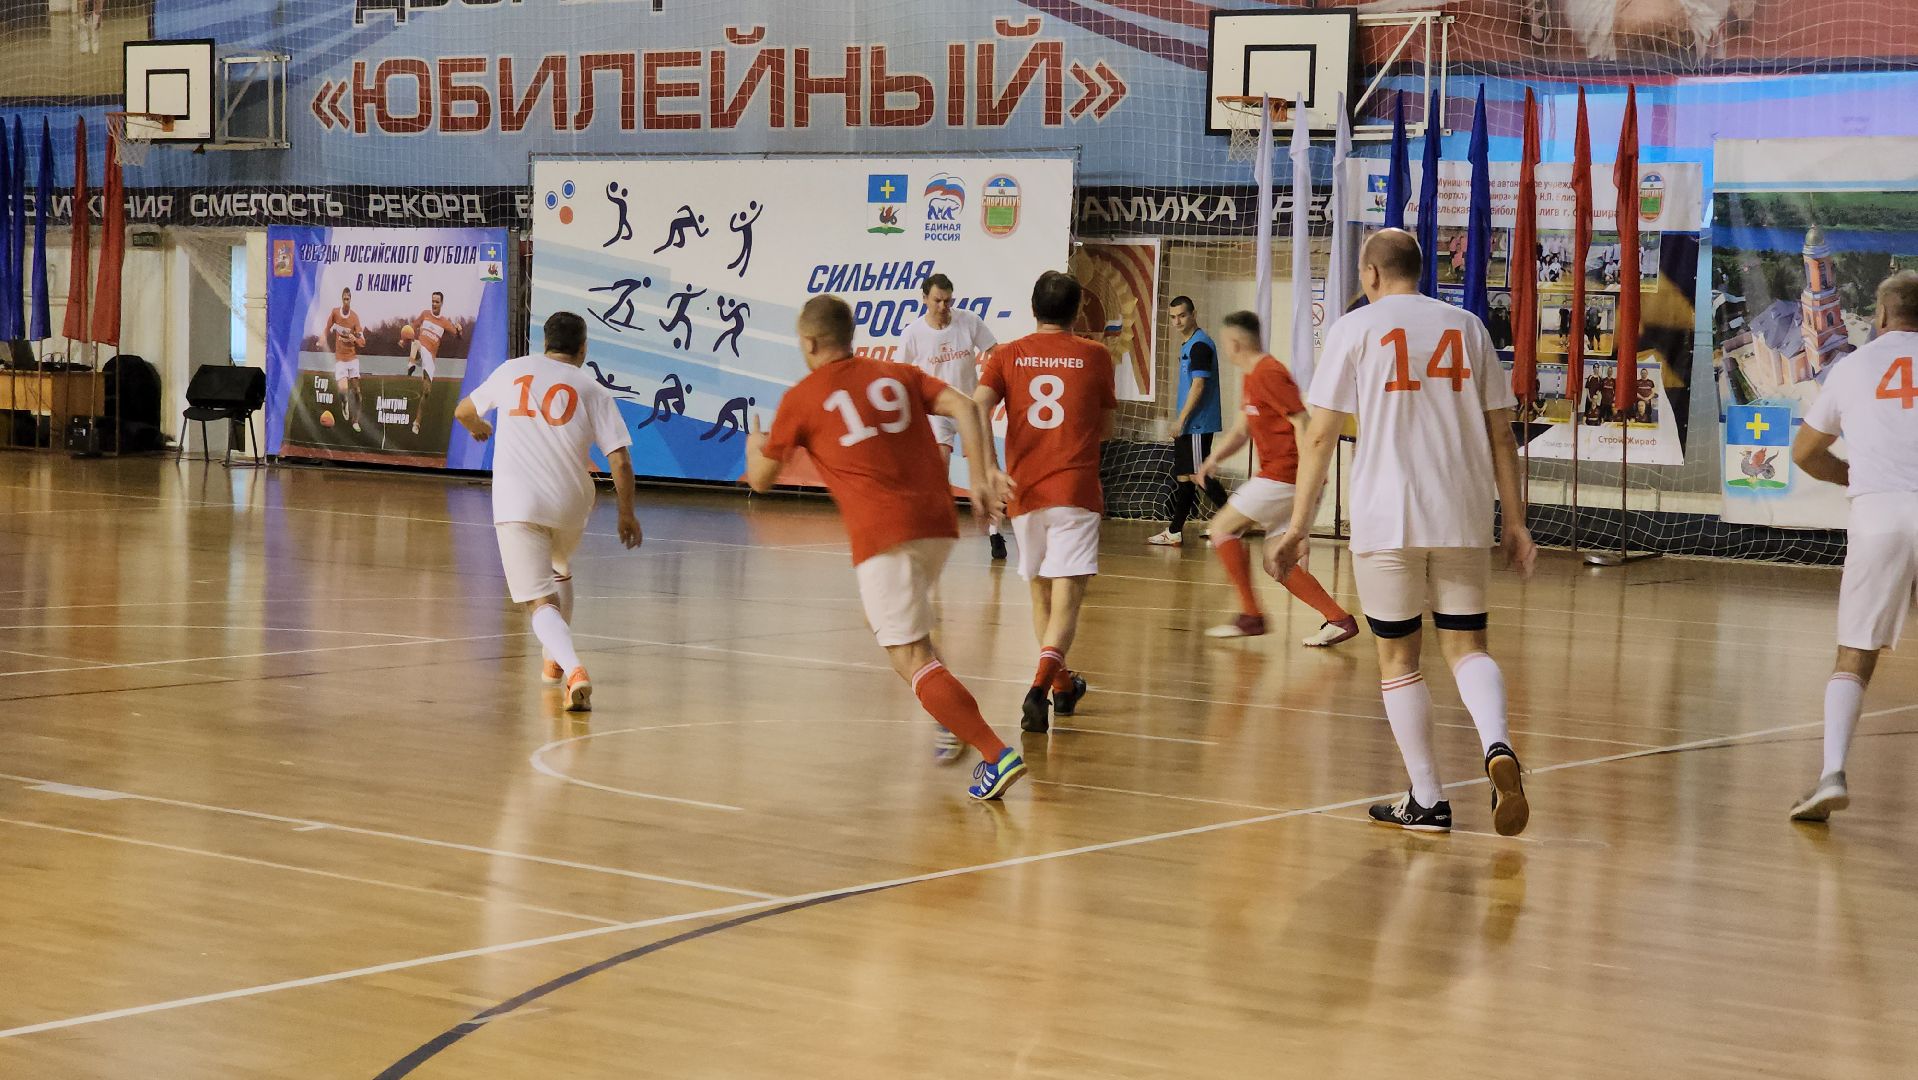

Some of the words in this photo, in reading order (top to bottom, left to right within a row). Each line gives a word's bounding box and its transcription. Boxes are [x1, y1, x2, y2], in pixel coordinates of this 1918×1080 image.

[311, 18, 1128, 135] «ЮБИЛЕЙНЫЙ»
[190, 193, 343, 217] СМЕЛОСТЬ
[369, 194, 486, 223] РЕКОРД
[1082, 196, 1237, 222] АМИКА
[925, 223, 961, 232] ЕДИНАЯ
[925, 233, 961, 241] РОССИЯ
[344, 243, 418, 264] РОССИЙСКОГО
[356, 273, 363, 291] В
[367, 273, 413, 292] КАШИРЕ
[807, 260, 935, 293] СИЛЬНАЯ
[1015, 356, 1084, 369] АЛЕНИЧЕВ
[1380, 327, 1471, 392] 14
[1876, 356, 1918, 410] 4
[508, 374, 578, 427] 10
[823, 377, 913, 447] 19
[1027, 374, 1065, 430] 8
